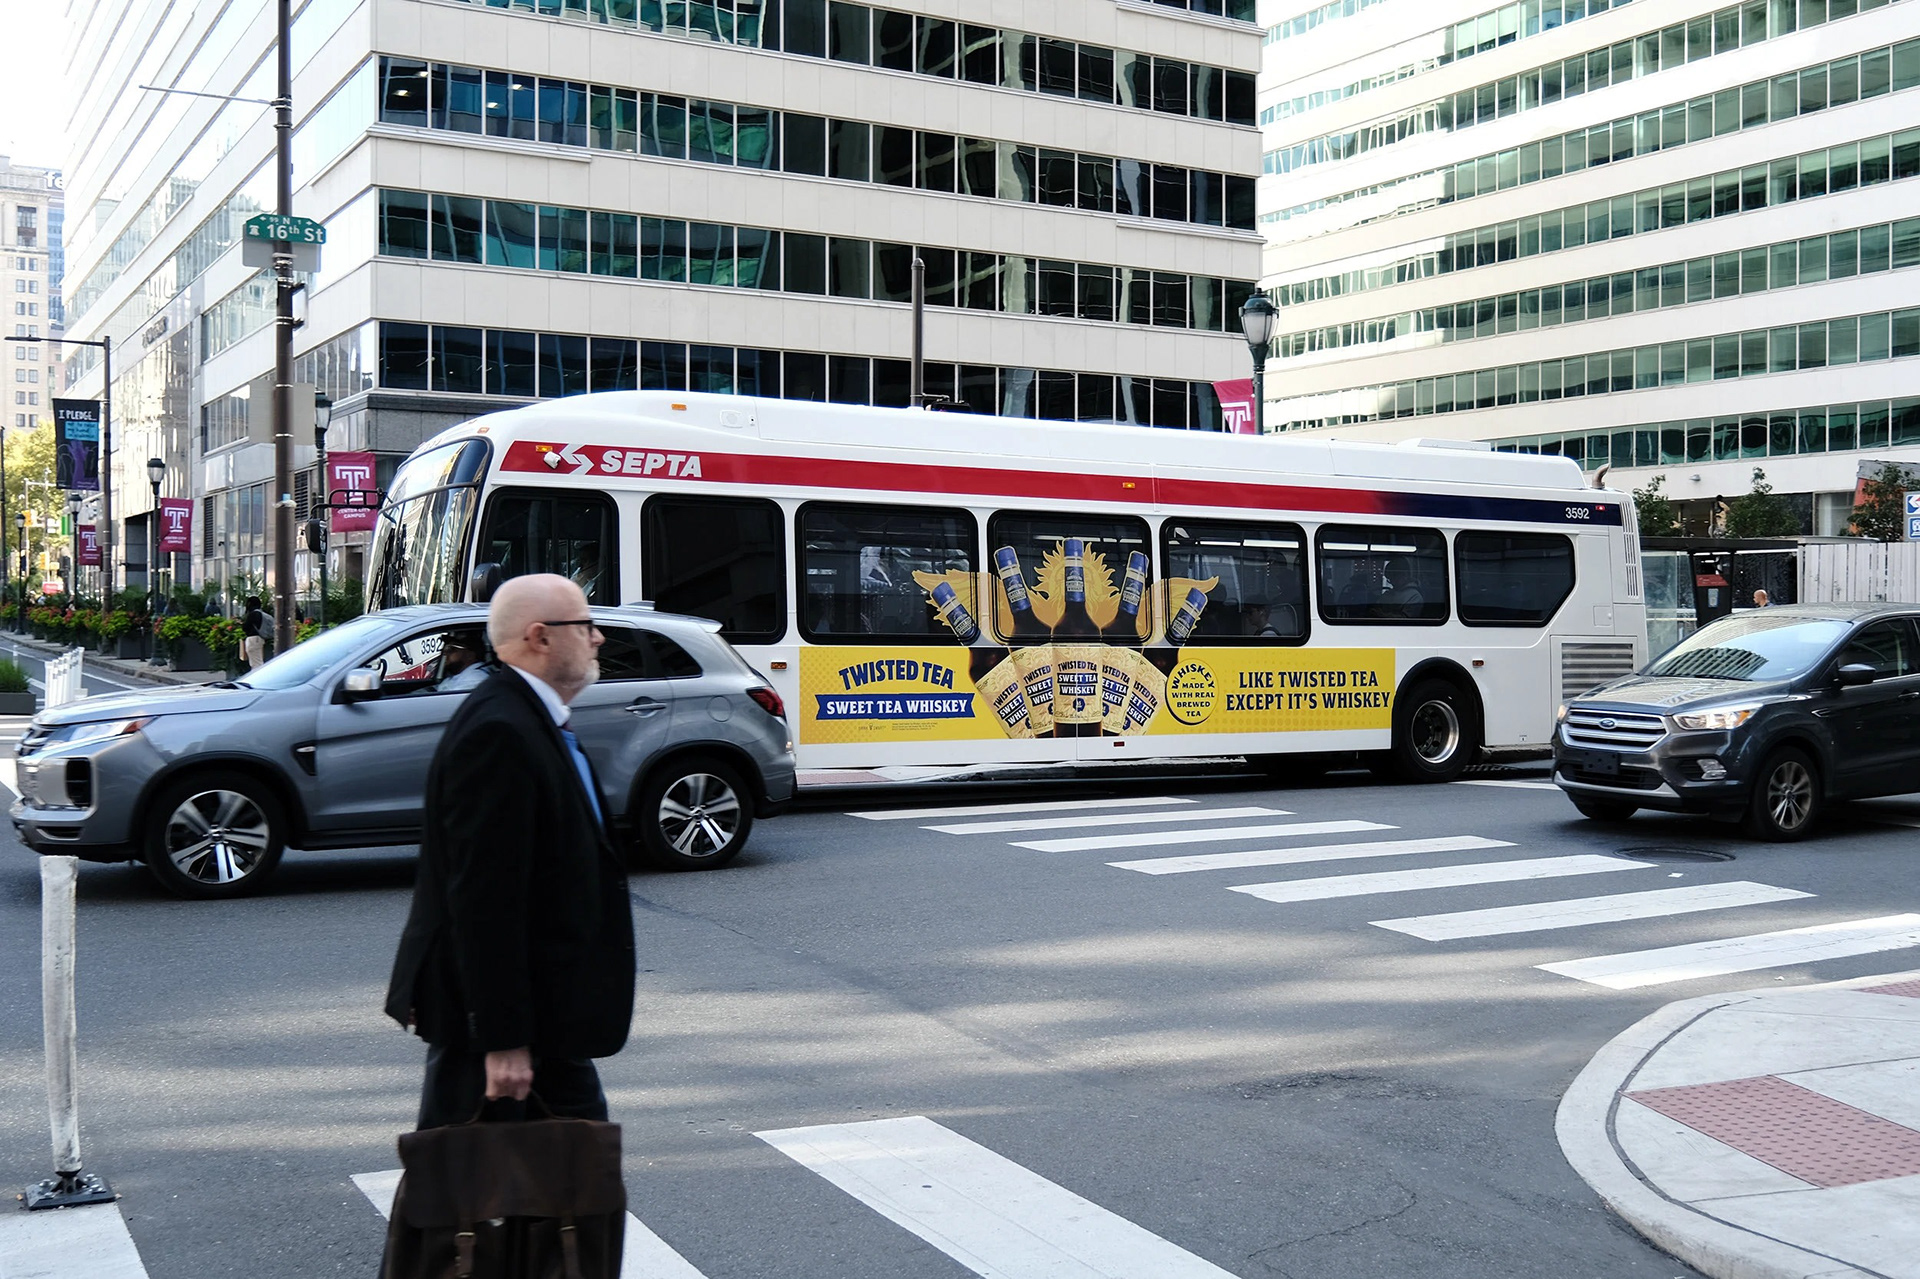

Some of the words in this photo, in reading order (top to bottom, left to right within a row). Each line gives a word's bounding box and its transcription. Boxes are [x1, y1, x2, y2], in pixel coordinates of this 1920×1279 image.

[267, 224, 300, 239] 16th
[304, 228, 323, 242] St
[59, 410, 65, 419] I
[600, 450, 702, 477] SEPTA
[1565, 507, 1590, 519] 3592
[421, 637, 442, 655] 3592
[1023, 665, 1051, 684] TWISTED
[1058, 661, 1086, 672] TWISTED
[1087, 662, 1097, 671] TEA
[838, 660, 919, 691] TWISTED
[922, 662, 954, 690] TEA
[1058, 674, 1084, 683] SWEET
[1085, 674, 1097, 682] TEA
[1120, 672, 1130, 684] TEA
[1172, 663, 1215, 689] WHISKEY
[1239, 672, 1274, 688] LIKE
[1278, 671, 1346, 688] TWISTED
[1350, 671, 1378, 687] TEA
[993, 682, 1019, 708] TWISTED
[1027, 679, 1052, 695] SWEET
[1061, 686, 1095, 694] WHISKEY
[1116, 685, 1127, 694] TEA
[826, 701, 874, 715] SWEET
[876, 700, 904, 714] TEA
[906, 699, 967, 713] WHISKEY
[1000, 695, 1023, 718] SWEET
[1140, 702, 1152, 716] TEA
[1149, 694, 1158, 708] TEA
[1226, 694, 1284, 711] EXCEPT
[1288, 693, 1318, 709] IT'S
[1321, 692, 1391, 709] WHISKEY
